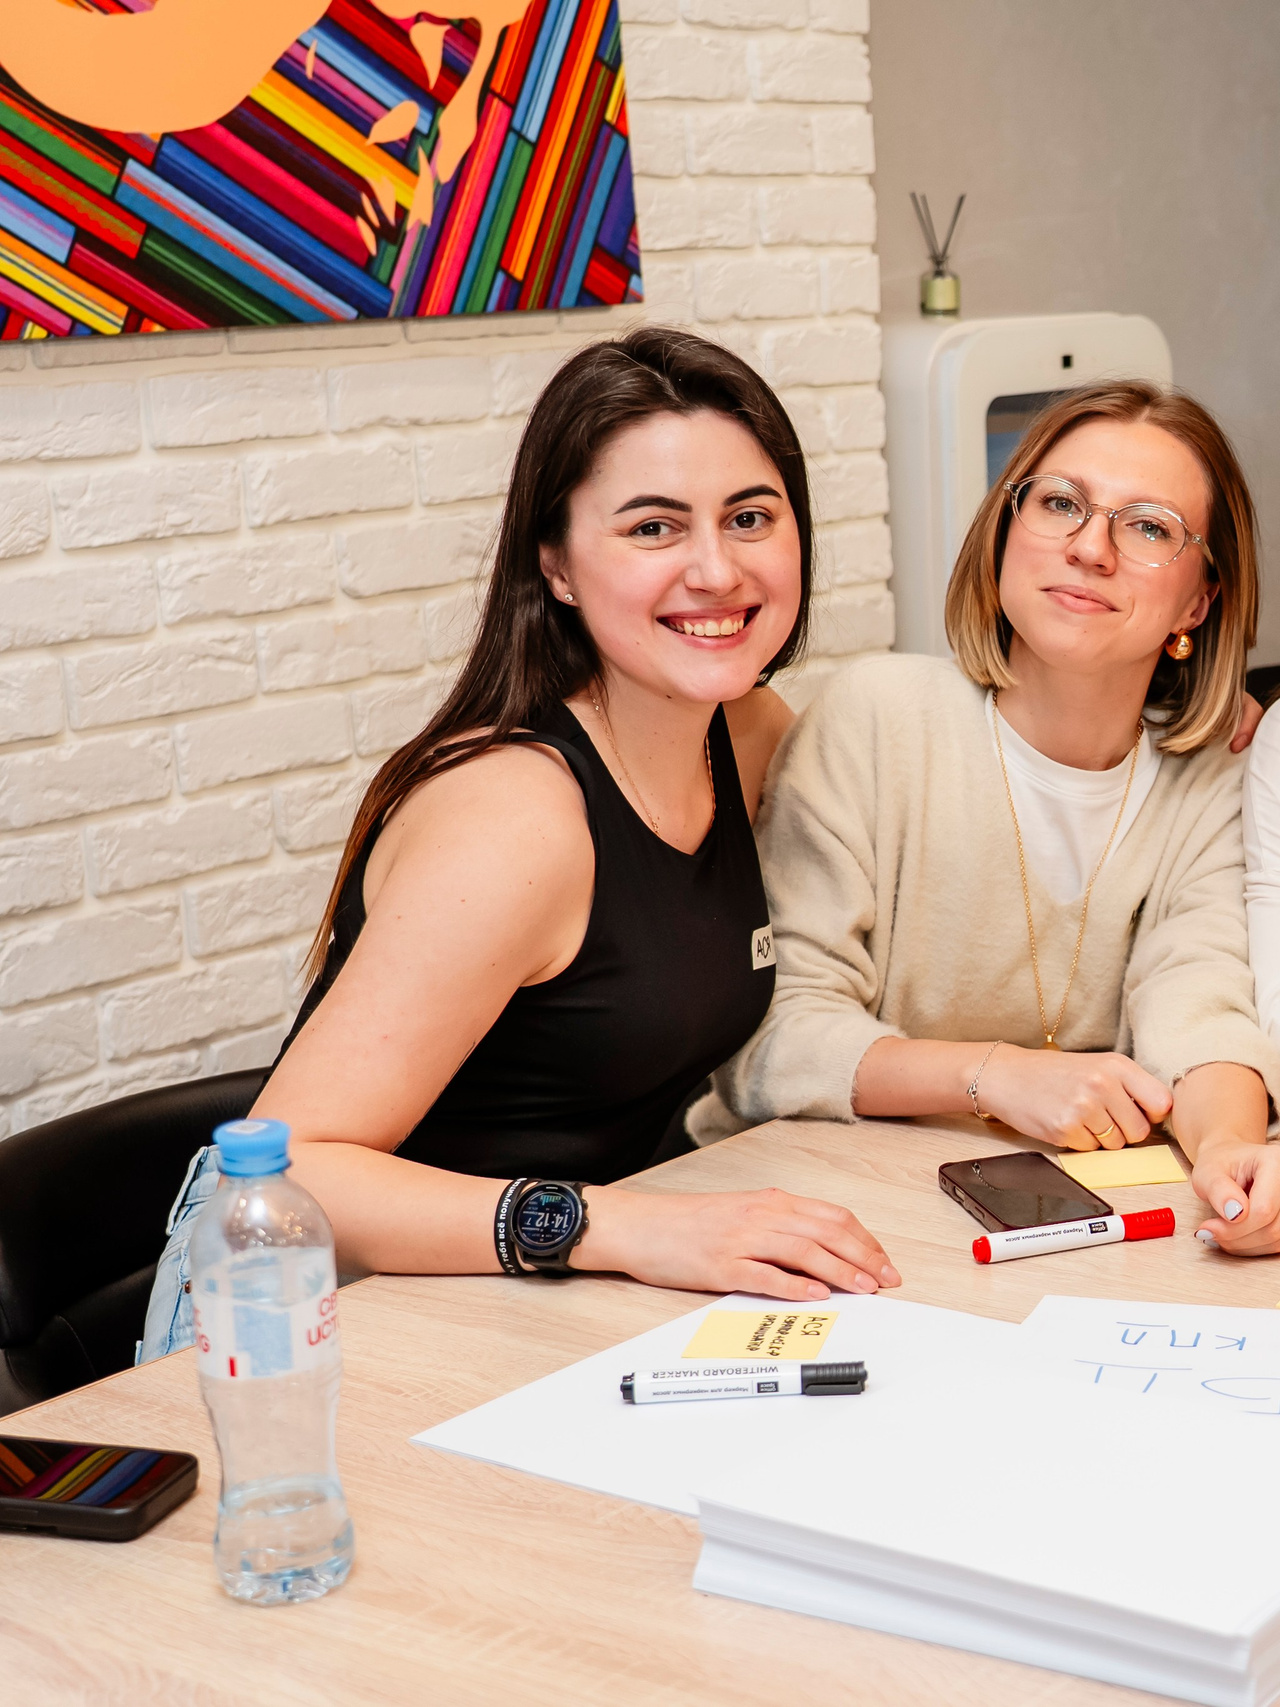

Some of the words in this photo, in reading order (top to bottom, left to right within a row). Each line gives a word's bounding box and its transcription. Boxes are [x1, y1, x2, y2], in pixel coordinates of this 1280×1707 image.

[497, 1222, 506, 1239] всё
[801, 1316, 828, 1335] АСЯ
[652, 1370, 700, 1379] MARKER
[703, 1365, 779, 1377] WHITEBOARD
